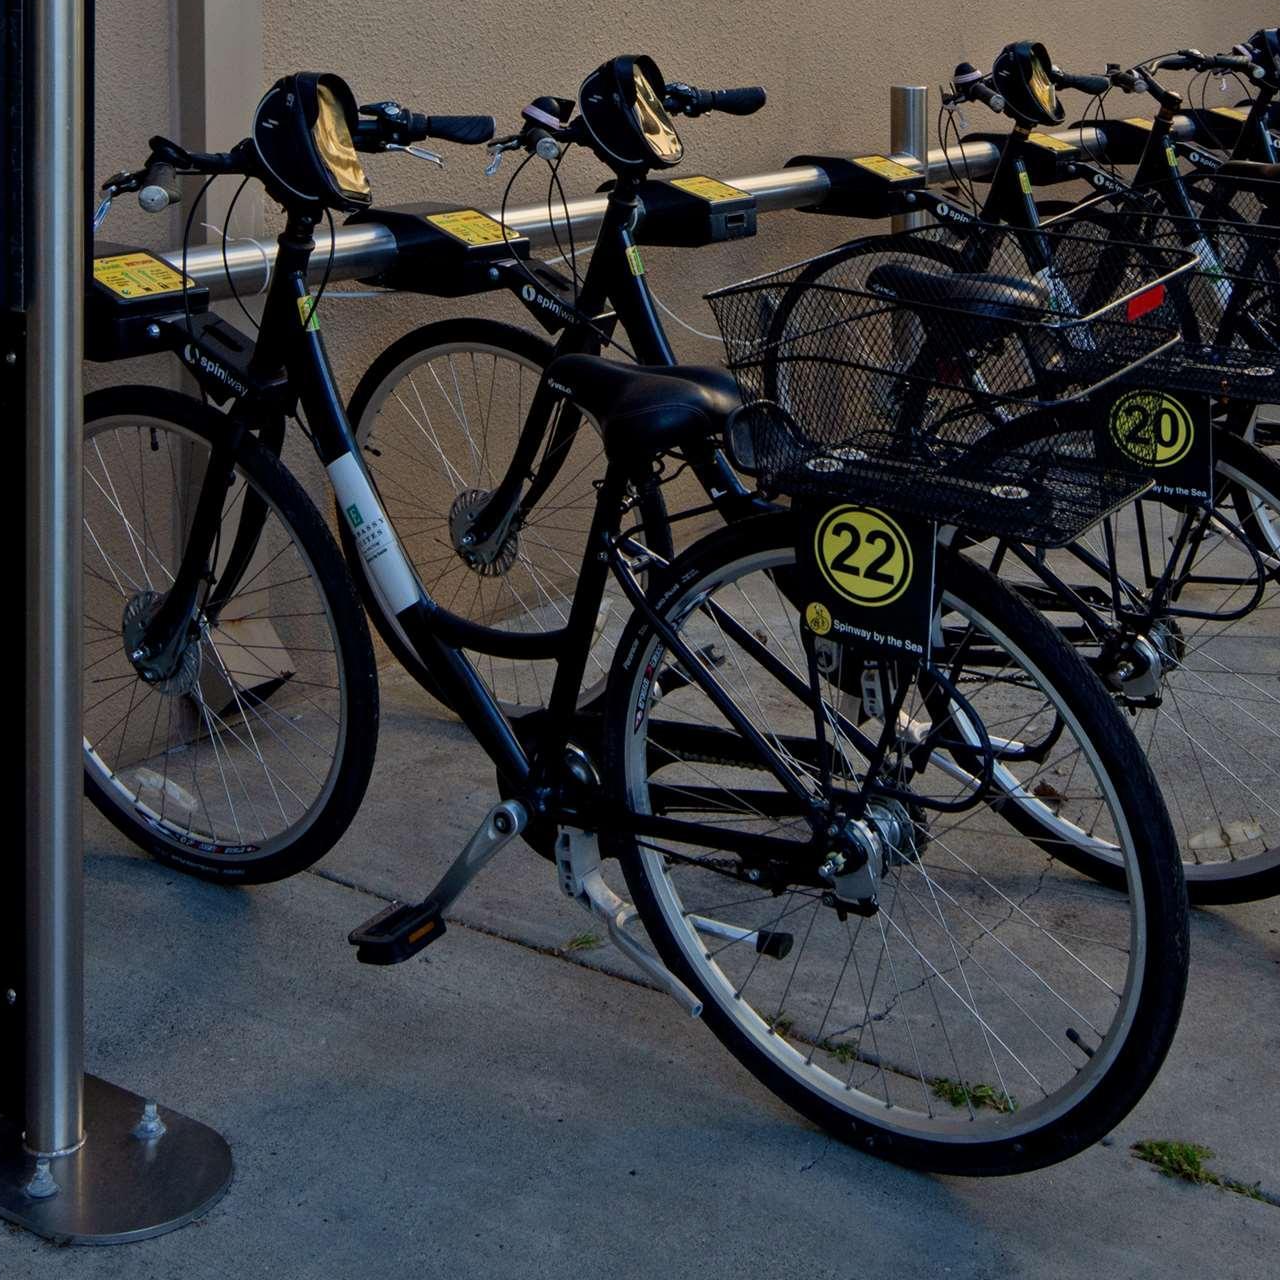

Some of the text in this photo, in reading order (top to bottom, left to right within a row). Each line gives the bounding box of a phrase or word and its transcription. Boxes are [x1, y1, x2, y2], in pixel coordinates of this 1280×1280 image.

[1125, 405, 1180, 448] 20
[1163, 485, 1174, 496] by
[1175, 486, 1190, 496] the
[1190, 487, 1208, 498] Sea
[831, 522, 896, 586] 22
[833, 618, 923, 654] Spinway by the Sea
